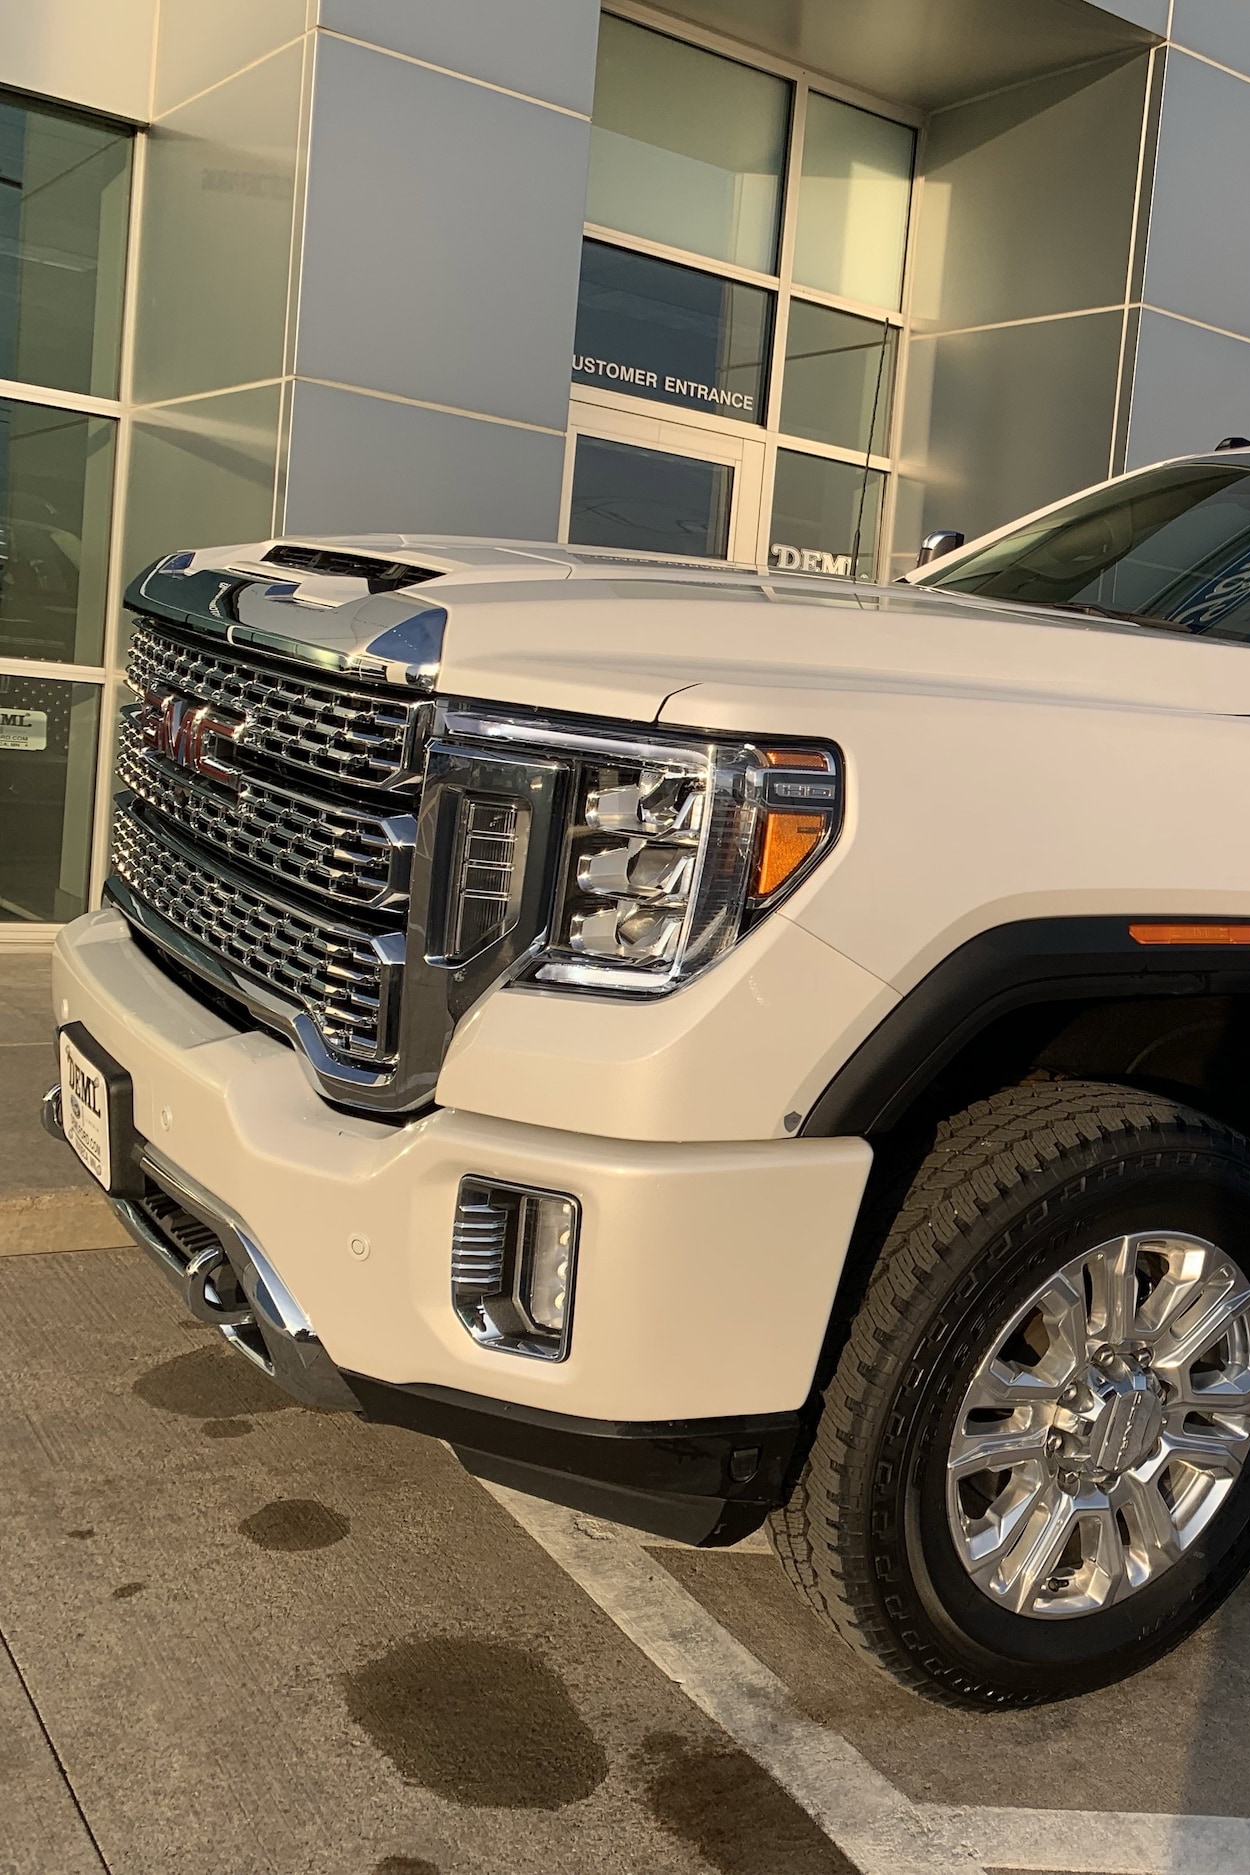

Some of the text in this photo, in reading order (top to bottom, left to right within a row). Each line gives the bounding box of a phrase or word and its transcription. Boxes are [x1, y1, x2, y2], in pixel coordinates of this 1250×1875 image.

[572, 354, 754, 411] USTOMER ENTRANCE
[771, 543, 869, 578] DEM
